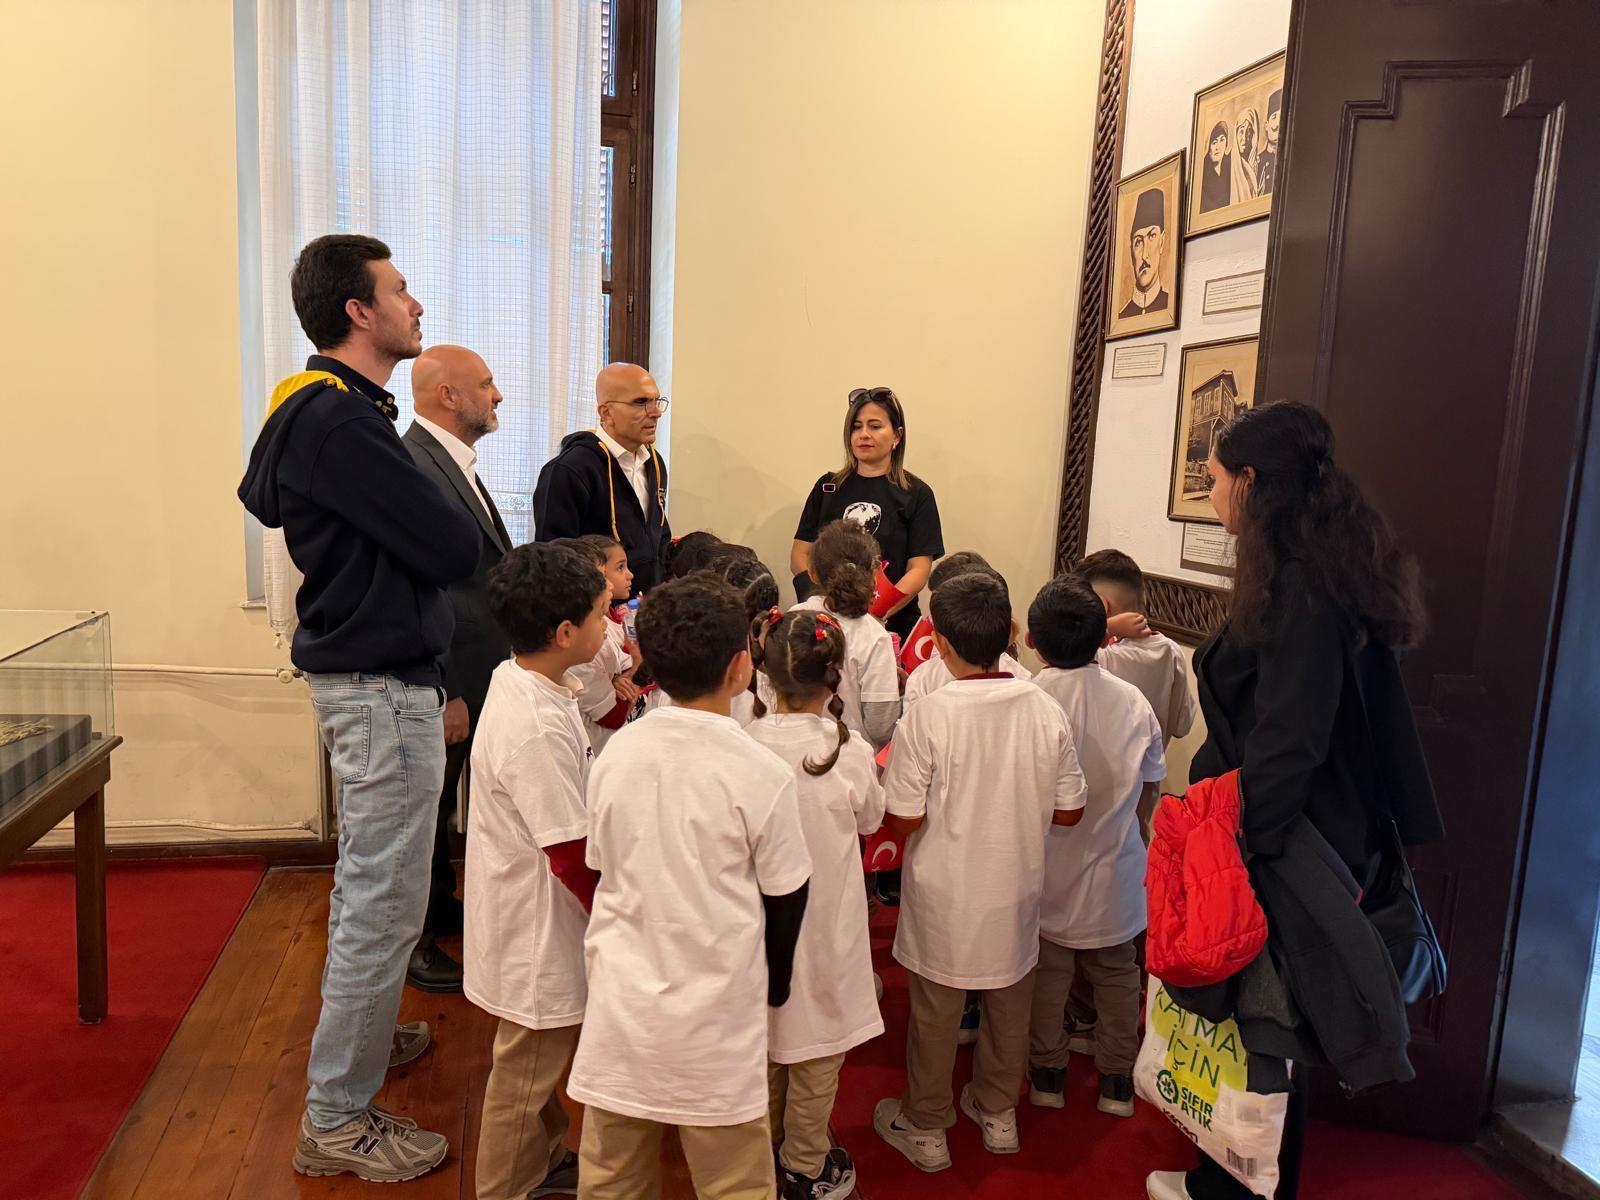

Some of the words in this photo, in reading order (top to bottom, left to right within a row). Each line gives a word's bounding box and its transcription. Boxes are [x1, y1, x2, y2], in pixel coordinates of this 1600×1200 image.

[1167, 1024, 1220, 1088] İÇİN
[1181, 1087, 1213, 1118] SIFIR
[1181, 1100, 1212, 1132] ATIK
